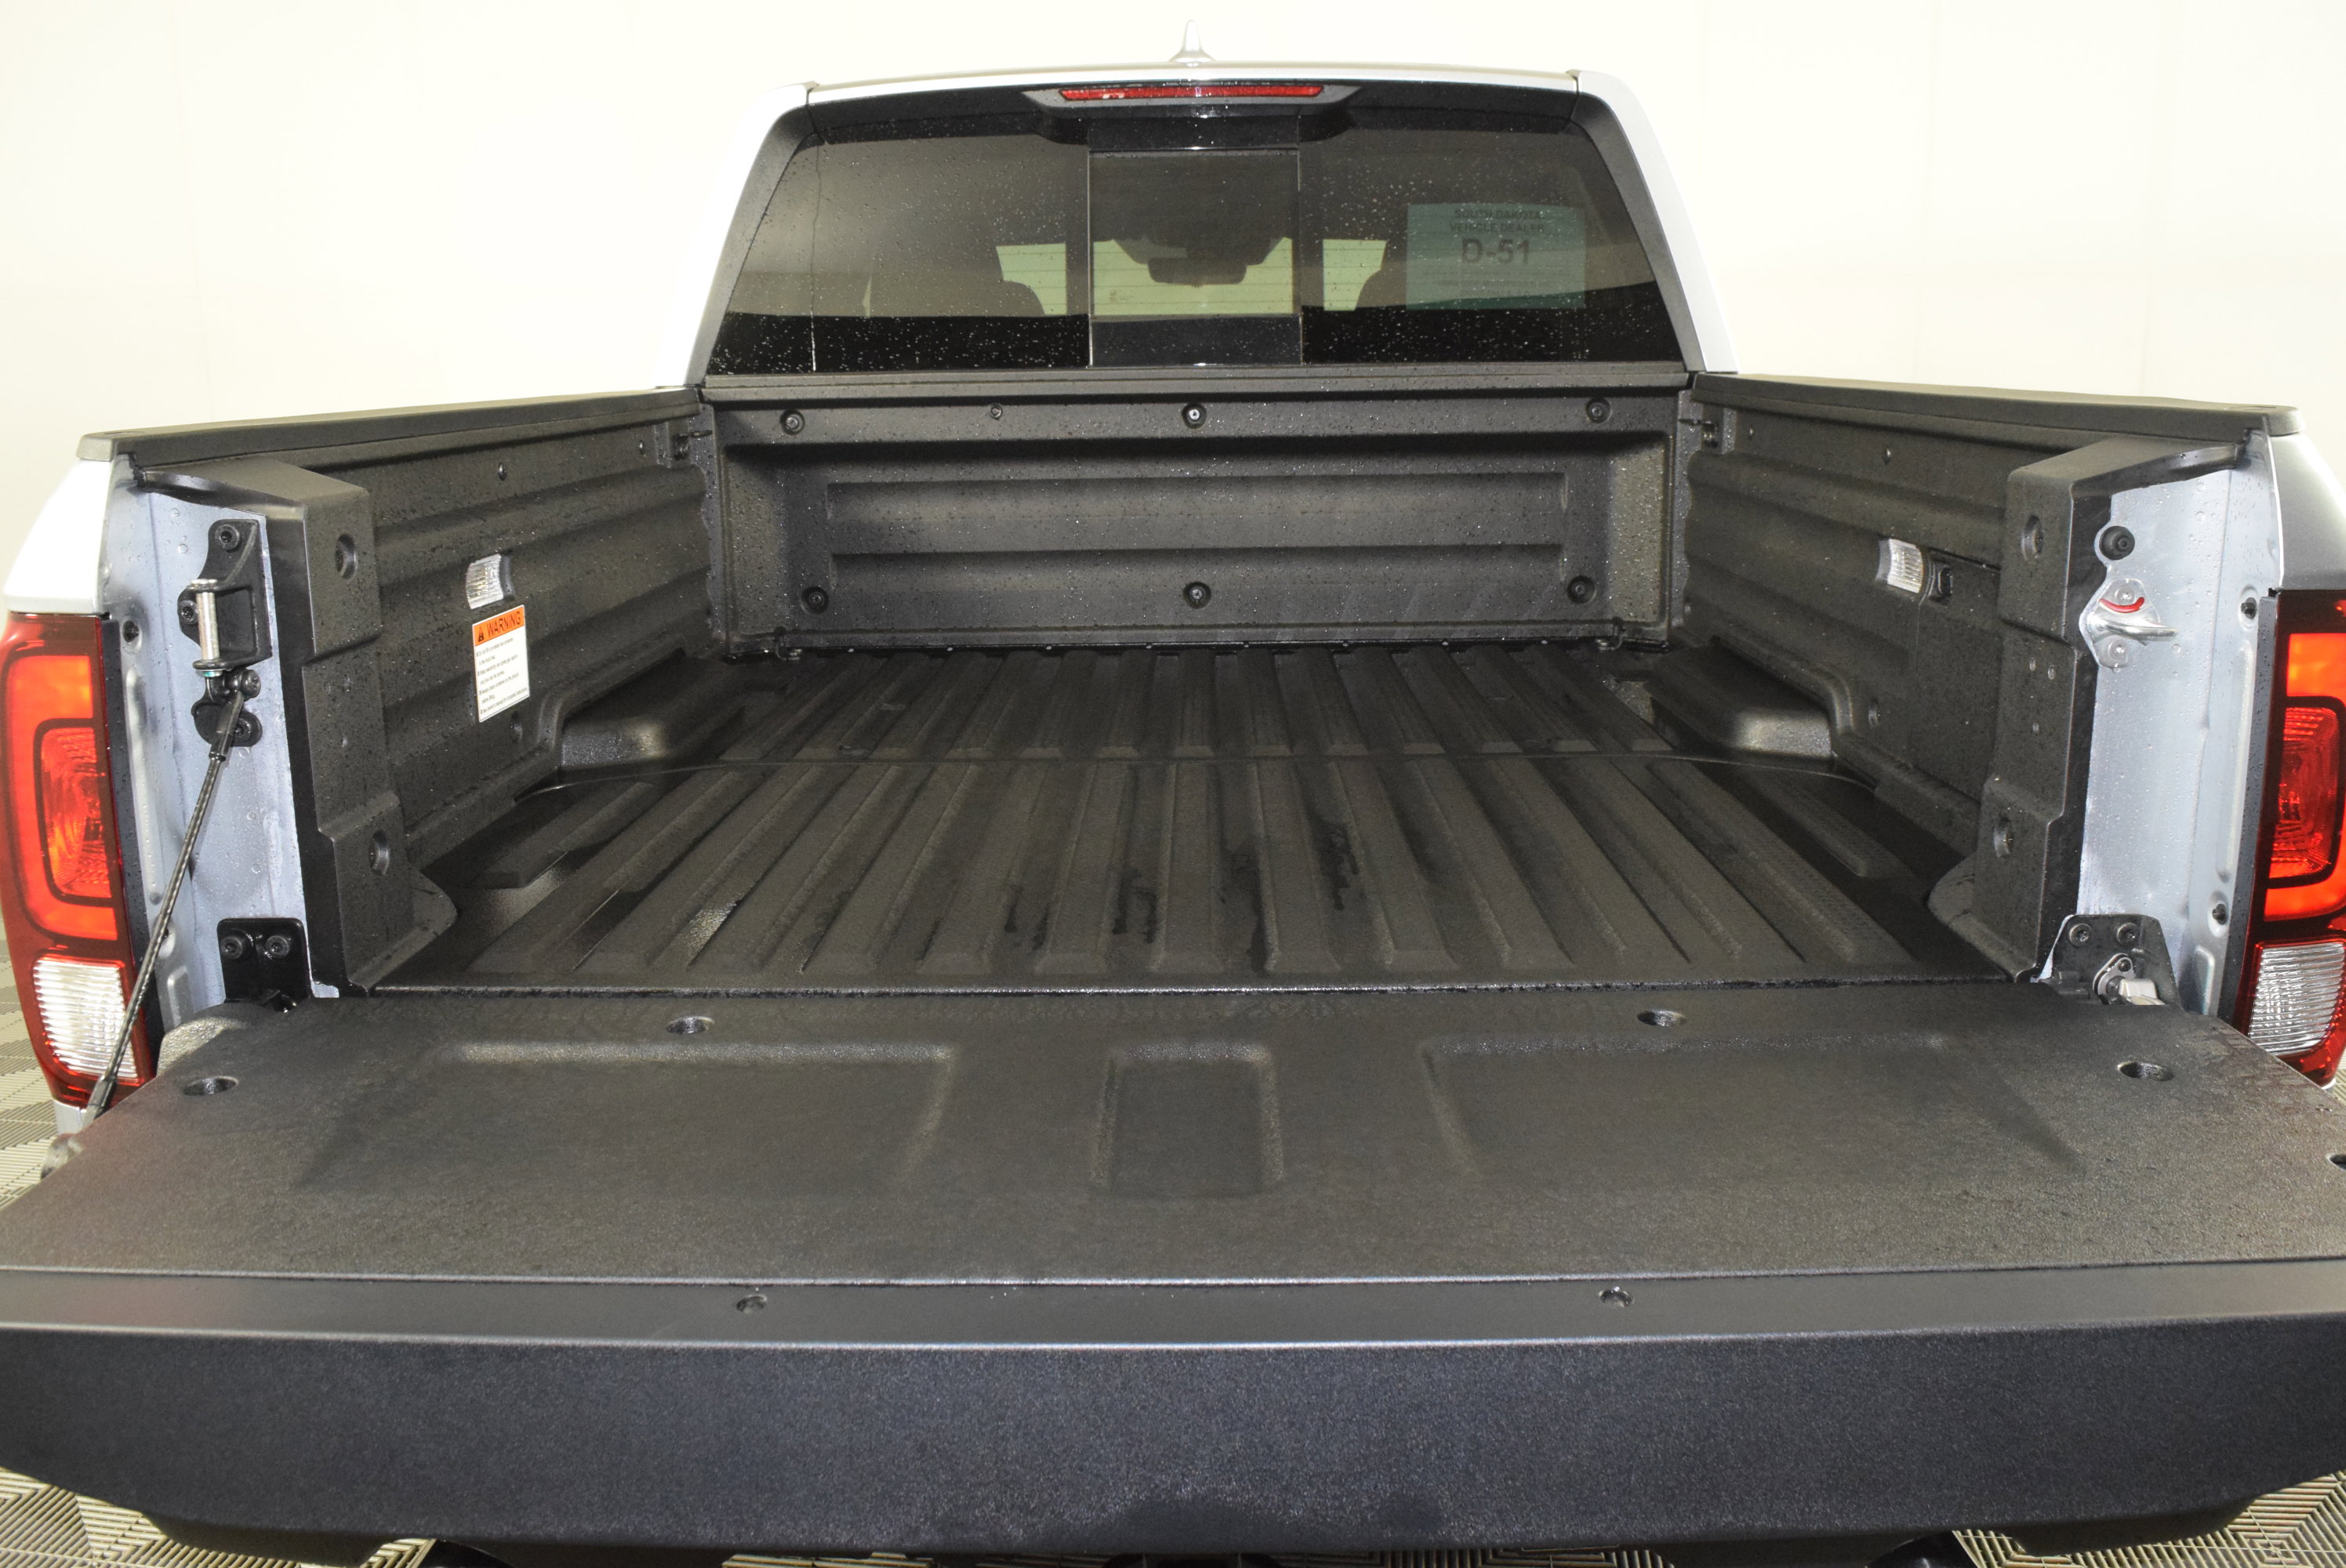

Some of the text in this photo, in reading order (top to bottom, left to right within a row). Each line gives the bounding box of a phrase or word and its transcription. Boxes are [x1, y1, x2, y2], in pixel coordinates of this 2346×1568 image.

[1454, 209, 1542, 220] SOUTH DAKOTA
[1449, 223, 1545, 233] VEHICLE DEALER
[1462, 238, 1529, 264] D-51
[486, 611, 521, 637] WARNING
